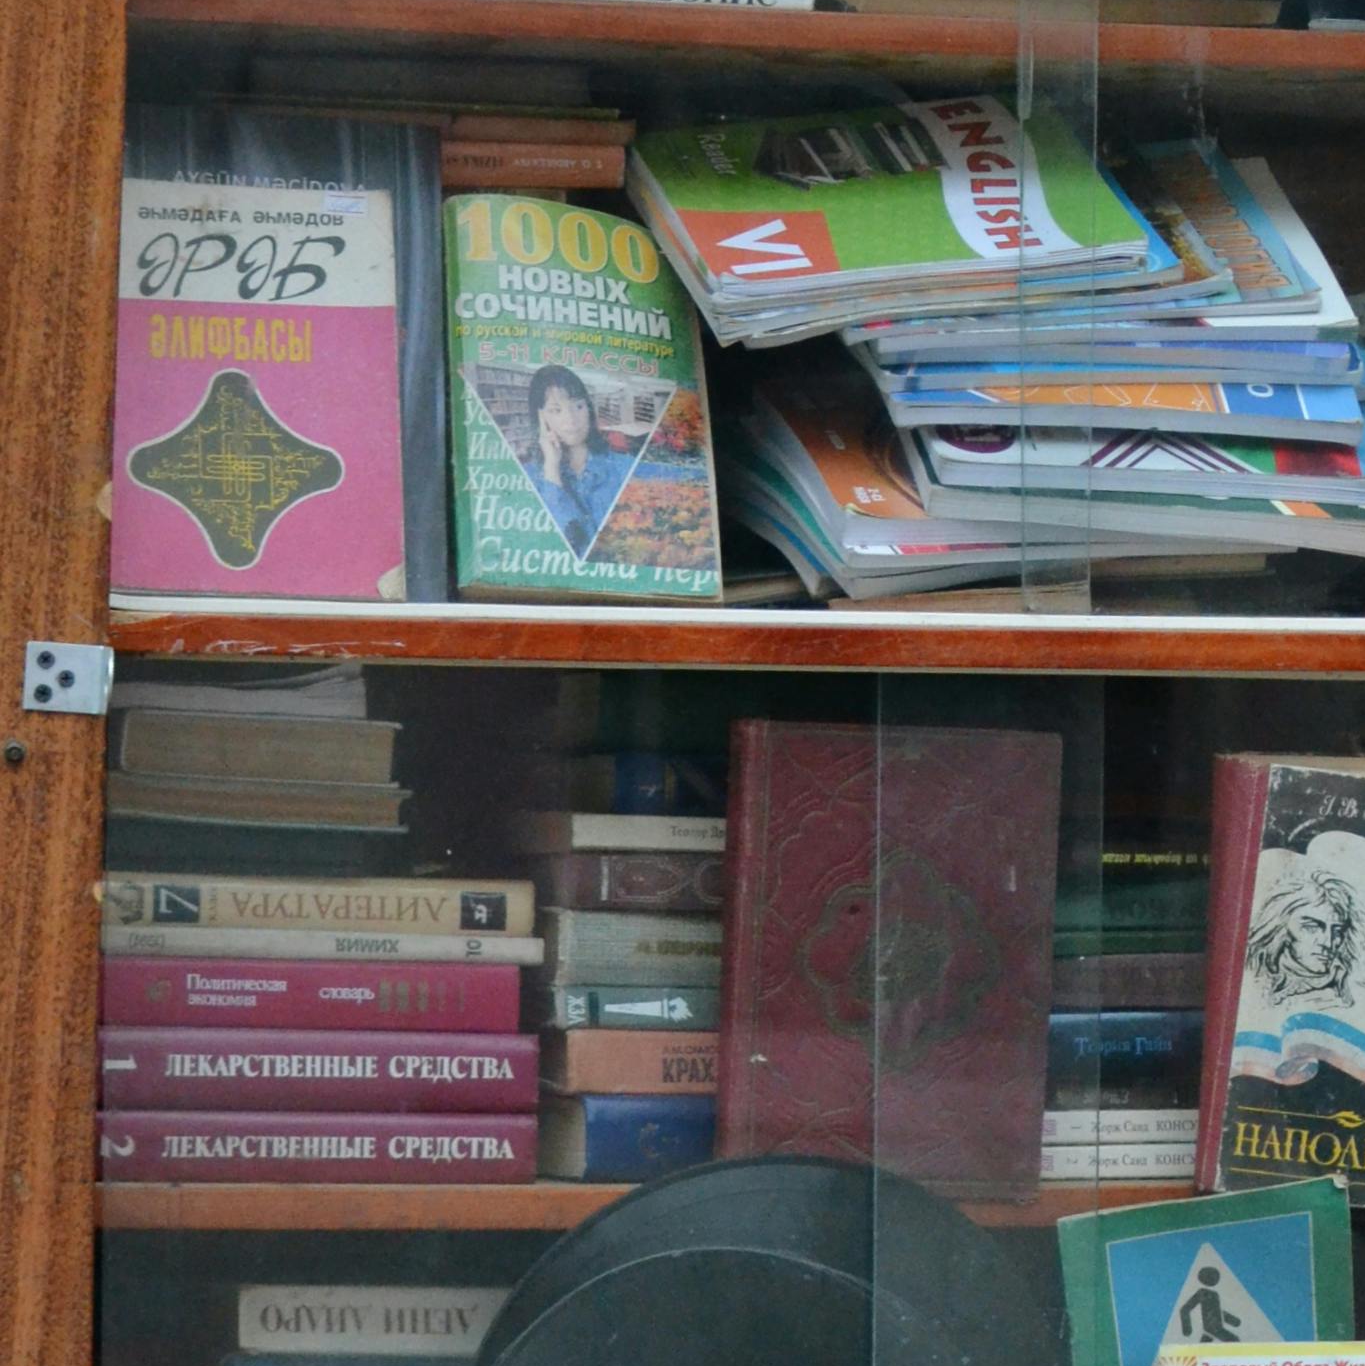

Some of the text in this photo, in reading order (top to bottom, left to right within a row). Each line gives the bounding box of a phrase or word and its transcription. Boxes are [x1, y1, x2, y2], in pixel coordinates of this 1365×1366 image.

[927, 98, 1045, 251] ENGLISH
[458, 200, 661, 284] 1000
[716, 218, 813, 275] VI
[137, 232, 346, 302] ӘРӘБ
[499, 263, 630, 306] НОВЫХ
[456, 291, 674, 341] СОЧИНЕНИЙ
[149, 314, 311, 363] ӘЛИФБАСЫ
[542, 329, 602, 346] мировой
[608, 336, 675, 359] литературе
[479, 341, 659, 376] 5-11 КЛАССЫ
[474, 494, 557, 531] Нова
[477, 535, 640, 578] Система
[229, 889, 449, 924] ЛИТЕРАТУРА
[333, 937, 400, 954] ХИМИЯ
[187, 973, 288, 993] Политическая
[187, 992, 257, 1007] экономия
[319, 986, 375, 1002] словарь
[165, 1053, 515, 1082] ЛЕКАРСТВЕННЫЕ СРЕДСТВА
[661, 1057, 717, 1084] КРАХ
[161, 1135, 515, 1164] ЛЕКАРСТВЕННЫЕ СРЕДСТВА
[259, 1303, 476, 1334] ДЕНИ ДИДРО
